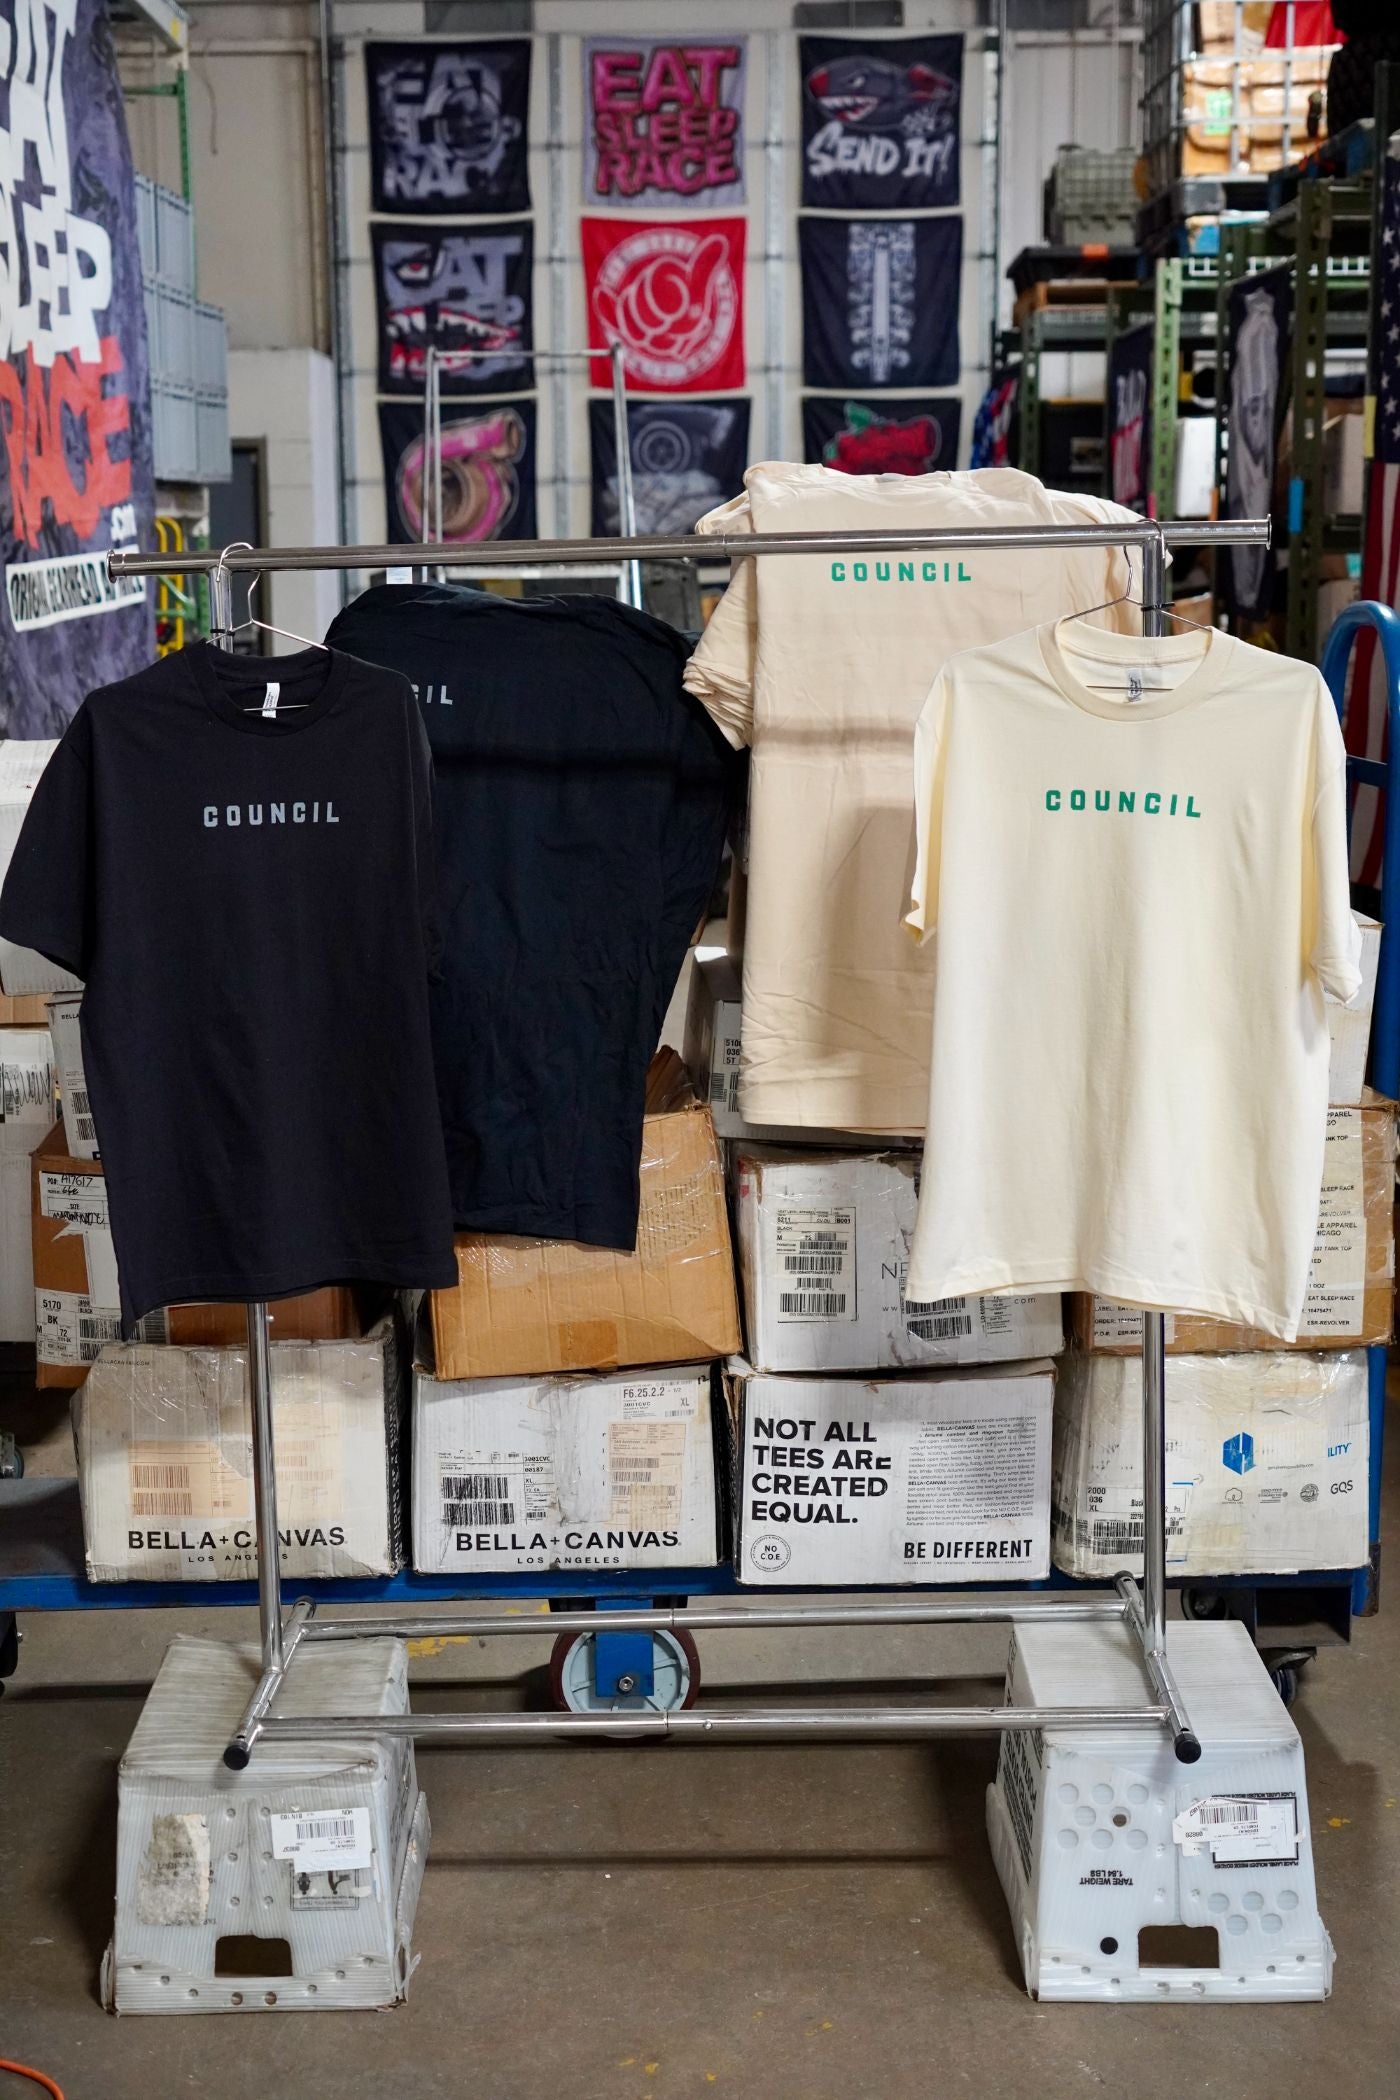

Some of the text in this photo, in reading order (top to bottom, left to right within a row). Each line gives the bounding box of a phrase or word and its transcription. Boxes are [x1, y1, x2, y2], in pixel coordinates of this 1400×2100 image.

[592, 47, 740, 114] EAT
[595, 106, 740, 151] SLEEP
[807, 120, 956, 182] SEND IT!
[595, 143, 740, 197] RACE
[831, 562, 972, 583] COUNCIL
[203, 801, 340, 828] COUNCIL
[1045, 789, 1201, 819] COUNCIL
[42, 1300, 61, 1310] 5170
[47, 1315, 58, 1325] BK
[59, 1328, 68, 1338] 72
[623, 1387, 665, 1398] F6.25.2.2
[680, 1397, 690, 1407] XL
[754, 1417, 877, 1442] NOT ALL
[752, 1444, 892, 1470] TEES ARE
[751, 1472, 889, 1498] CREATED
[1088, 1487, 1106, 1495] 2000
[751, 1500, 859, 1524] EQUAL.
[128, 1526, 345, 1549] BELLA+CNVAS
[456, 1531, 679, 1552] BELLA+CANVAS
[188, 1553, 288, 1563] LOS ANGS
[904, 1540, 1032, 1558] BE DIFFERENT
[1079, 1877, 1133, 1885] TARE WEIGHT
